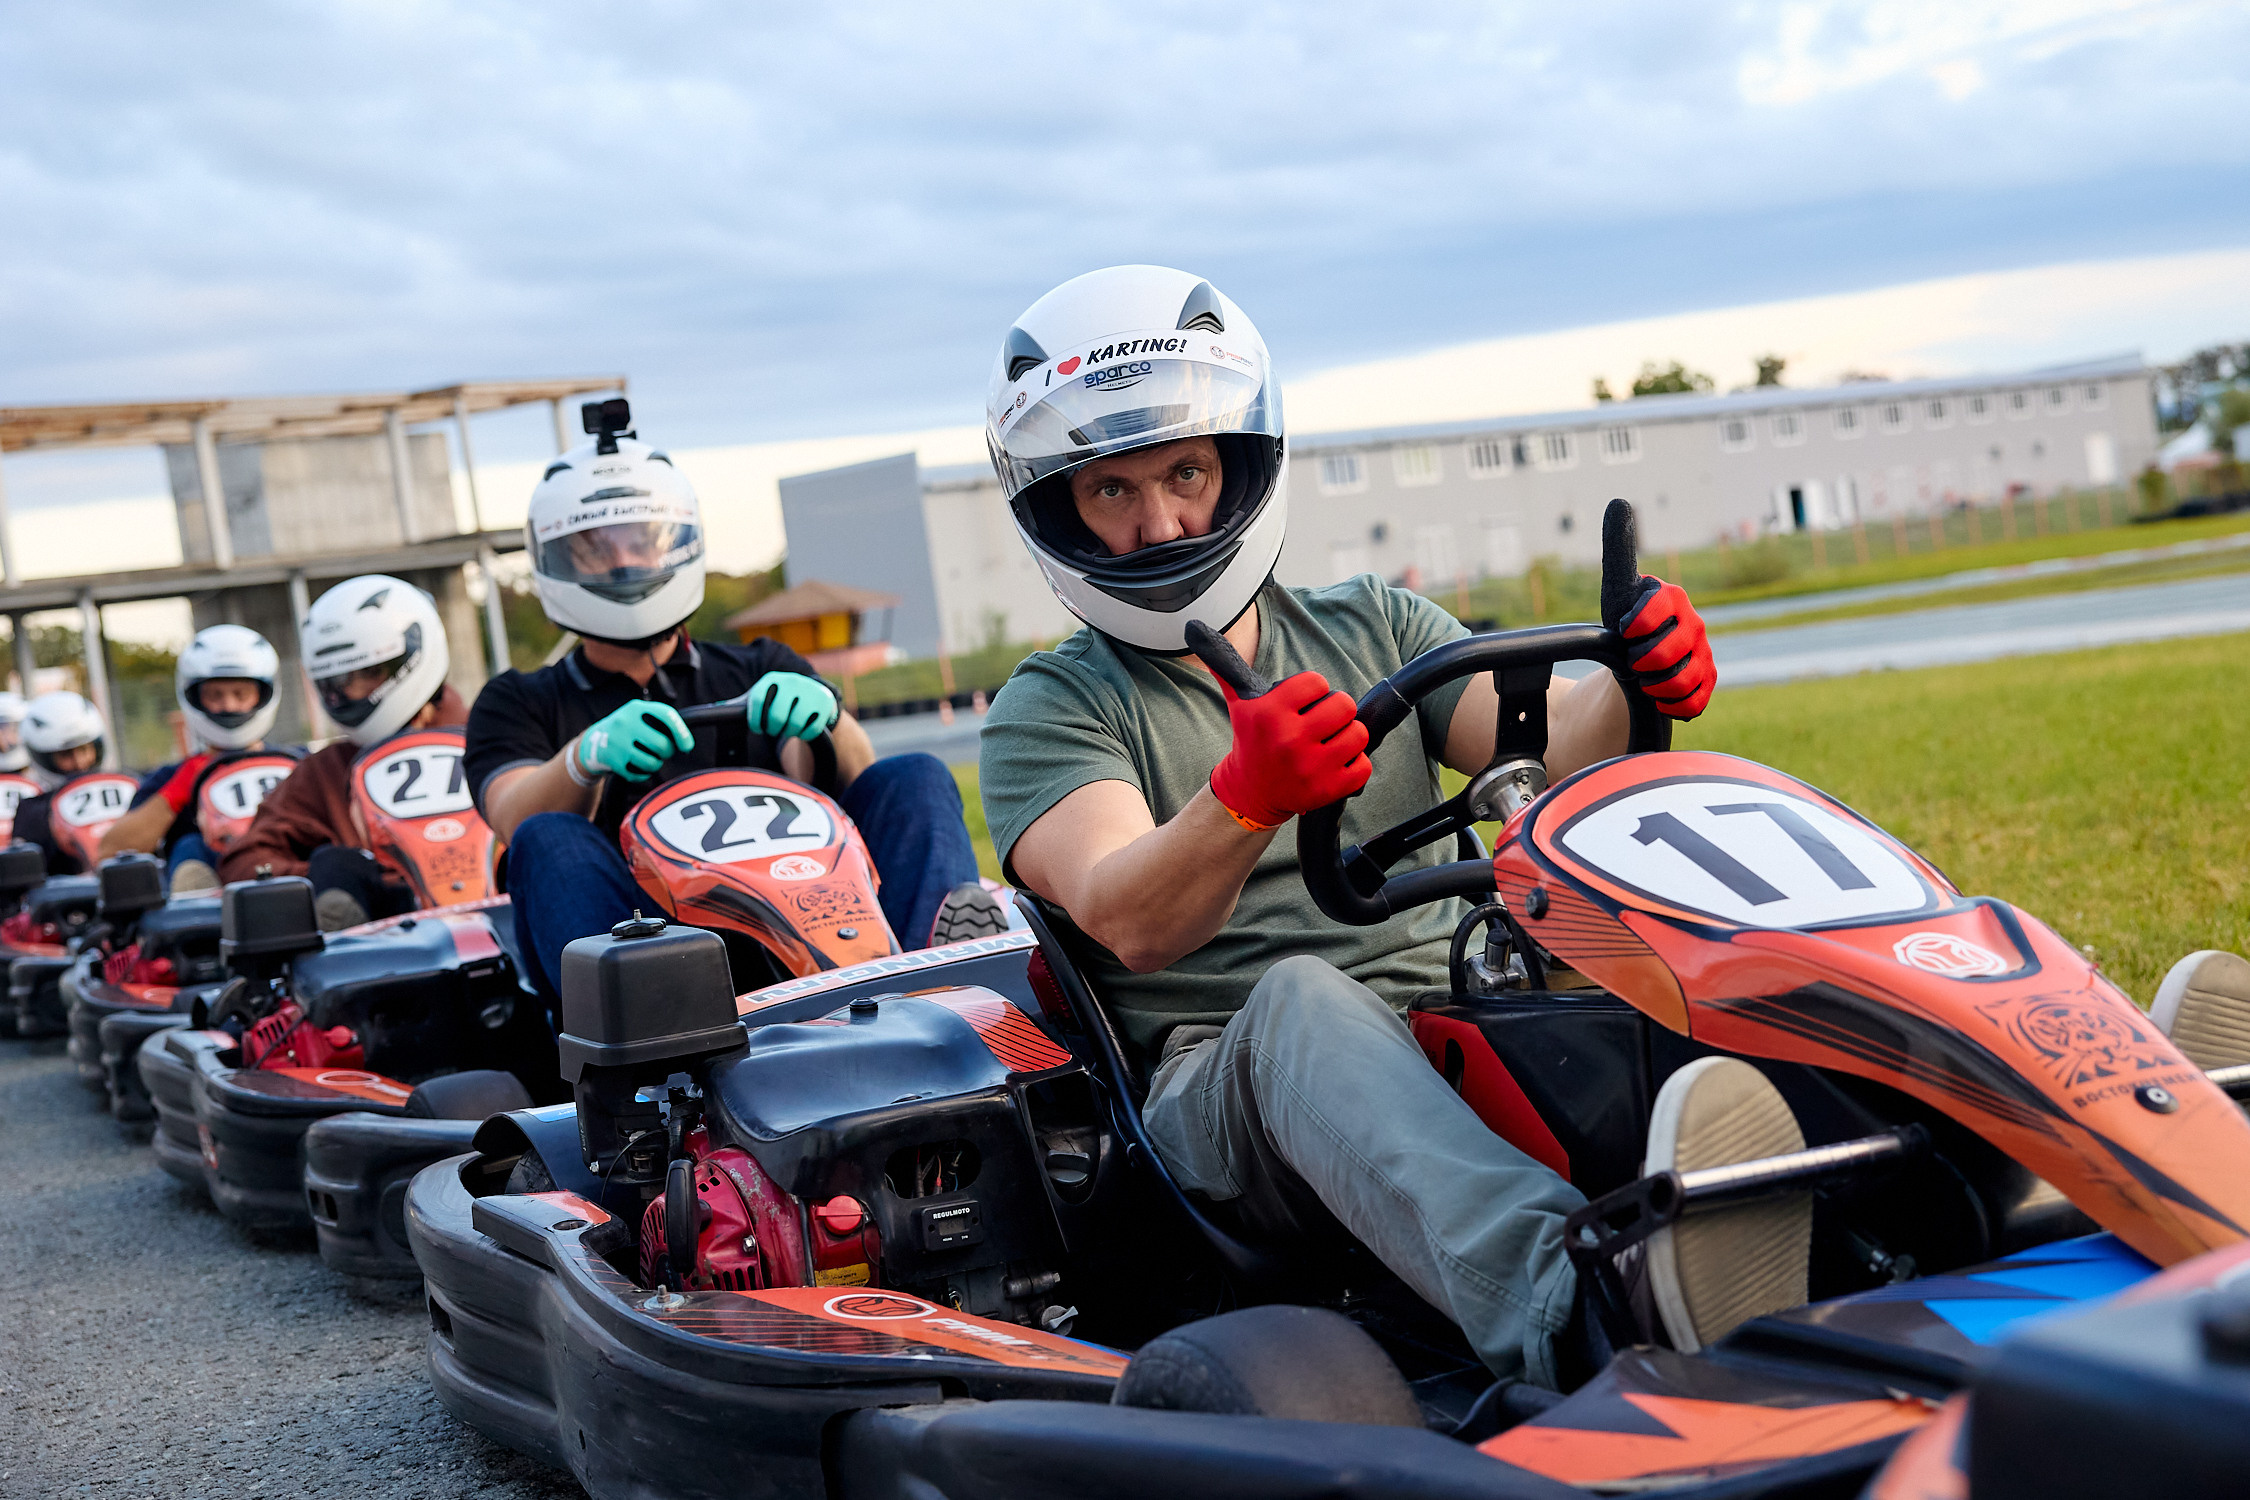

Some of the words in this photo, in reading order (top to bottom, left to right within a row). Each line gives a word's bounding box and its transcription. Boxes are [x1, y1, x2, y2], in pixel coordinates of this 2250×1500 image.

[1045, 369, 1052, 386] I
[1087, 338, 1188, 365] KARTING!
[1084, 361, 1151, 385] sparco
[72, 788, 122, 816] 20
[388, 755, 464, 804] 27
[681, 795, 821, 853] 22
[1629, 802, 1877, 906] 17
[932, 1207, 970, 1220] REGULMOTO
